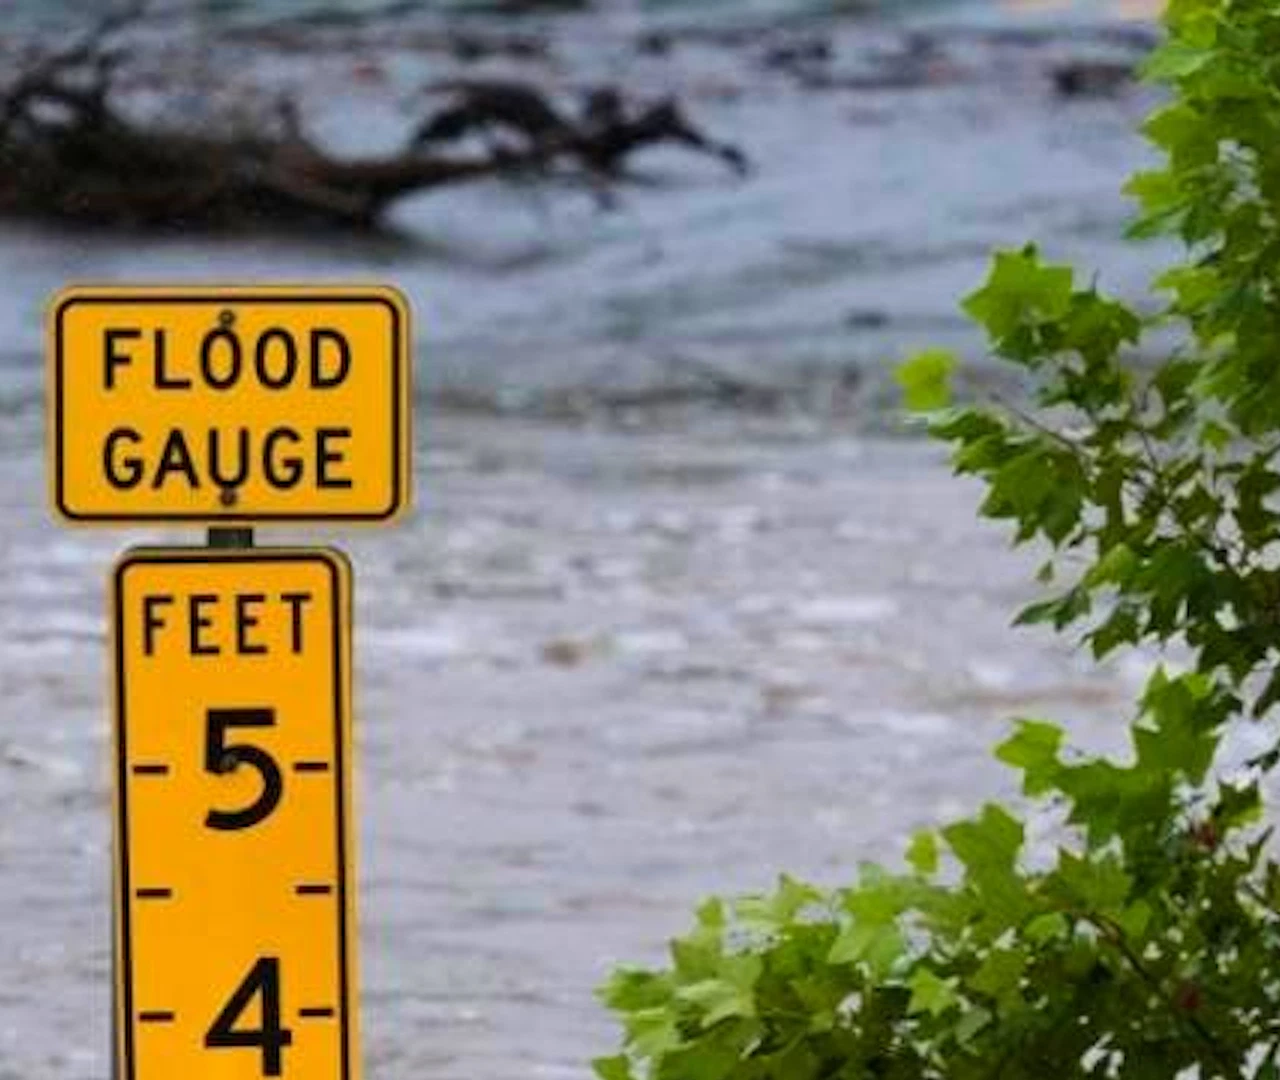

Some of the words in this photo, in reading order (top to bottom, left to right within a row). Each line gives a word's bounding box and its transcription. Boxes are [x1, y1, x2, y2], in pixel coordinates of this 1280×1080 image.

[103, 327, 353, 391] FLOOD
[102, 427, 354, 490] GAUGE
[142, 592, 312, 656] FEET
[204, 707, 284, 832] 5
[204, 956, 293, 1078] 4
